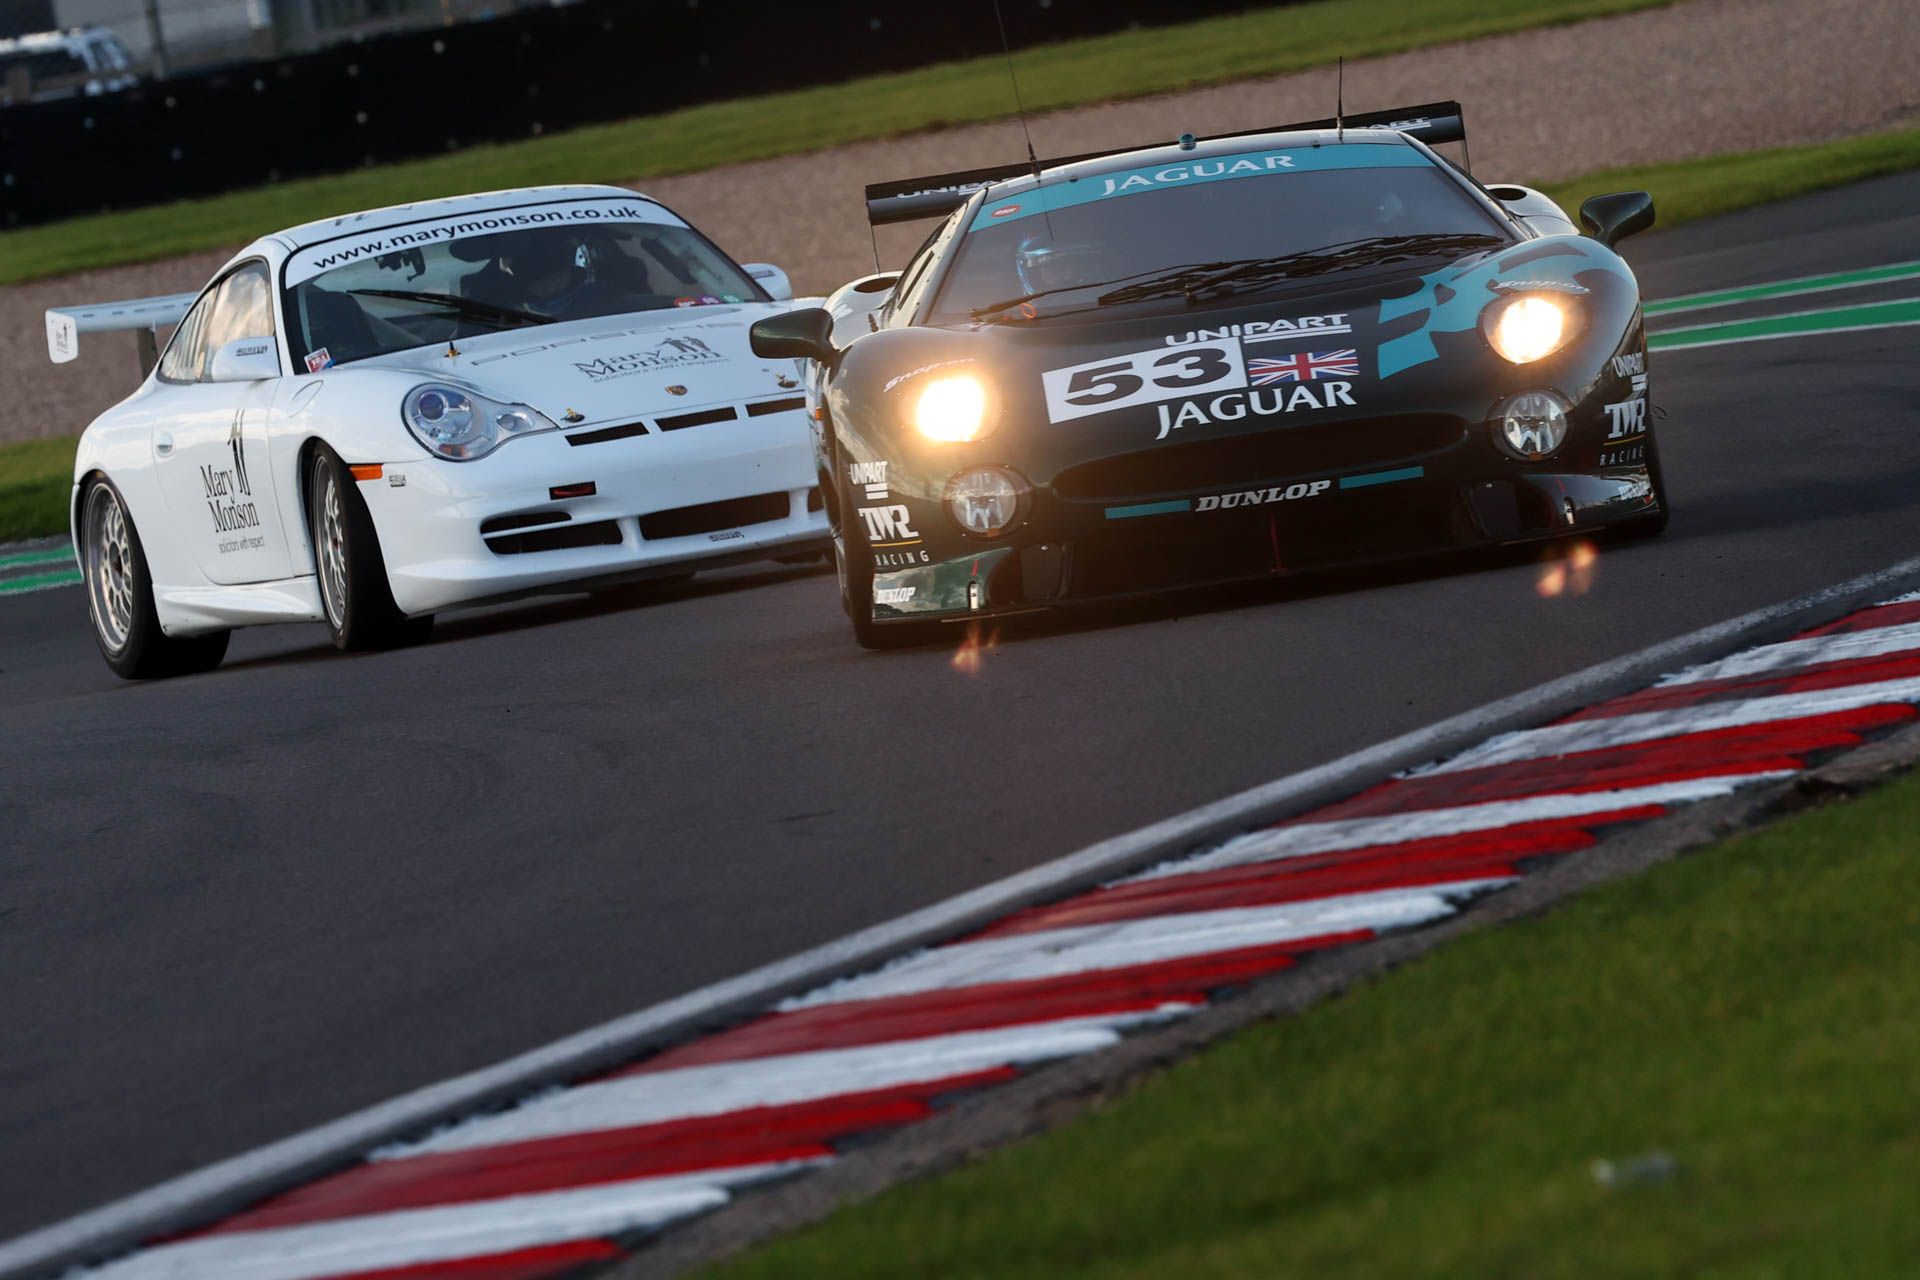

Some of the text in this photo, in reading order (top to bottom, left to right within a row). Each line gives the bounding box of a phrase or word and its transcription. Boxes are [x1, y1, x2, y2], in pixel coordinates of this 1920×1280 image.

[1101, 155, 1297, 197] JAGUAR
[313, 206, 642, 270] www.marymonson.co.uk
[1165, 313, 1352, 346] UNIPART
[571, 349, 661, 370] Mary
[580, 350, 722, 378] Monson
[1064, 347, 1232, 406] 53
[1155, 381, 1358, 440] JAGUAR
[1604, 398, 1646, 439] TWR
[200, 464, 235, 504] Mary
[849, 461, 888, 485] UNIPART
[1195, 480, 1332, 512] DUNLOP
[208, 500, 260, 532] Monson
[857, 504, 920, 541] TWR
[874, 550, 930, 566] RACING
